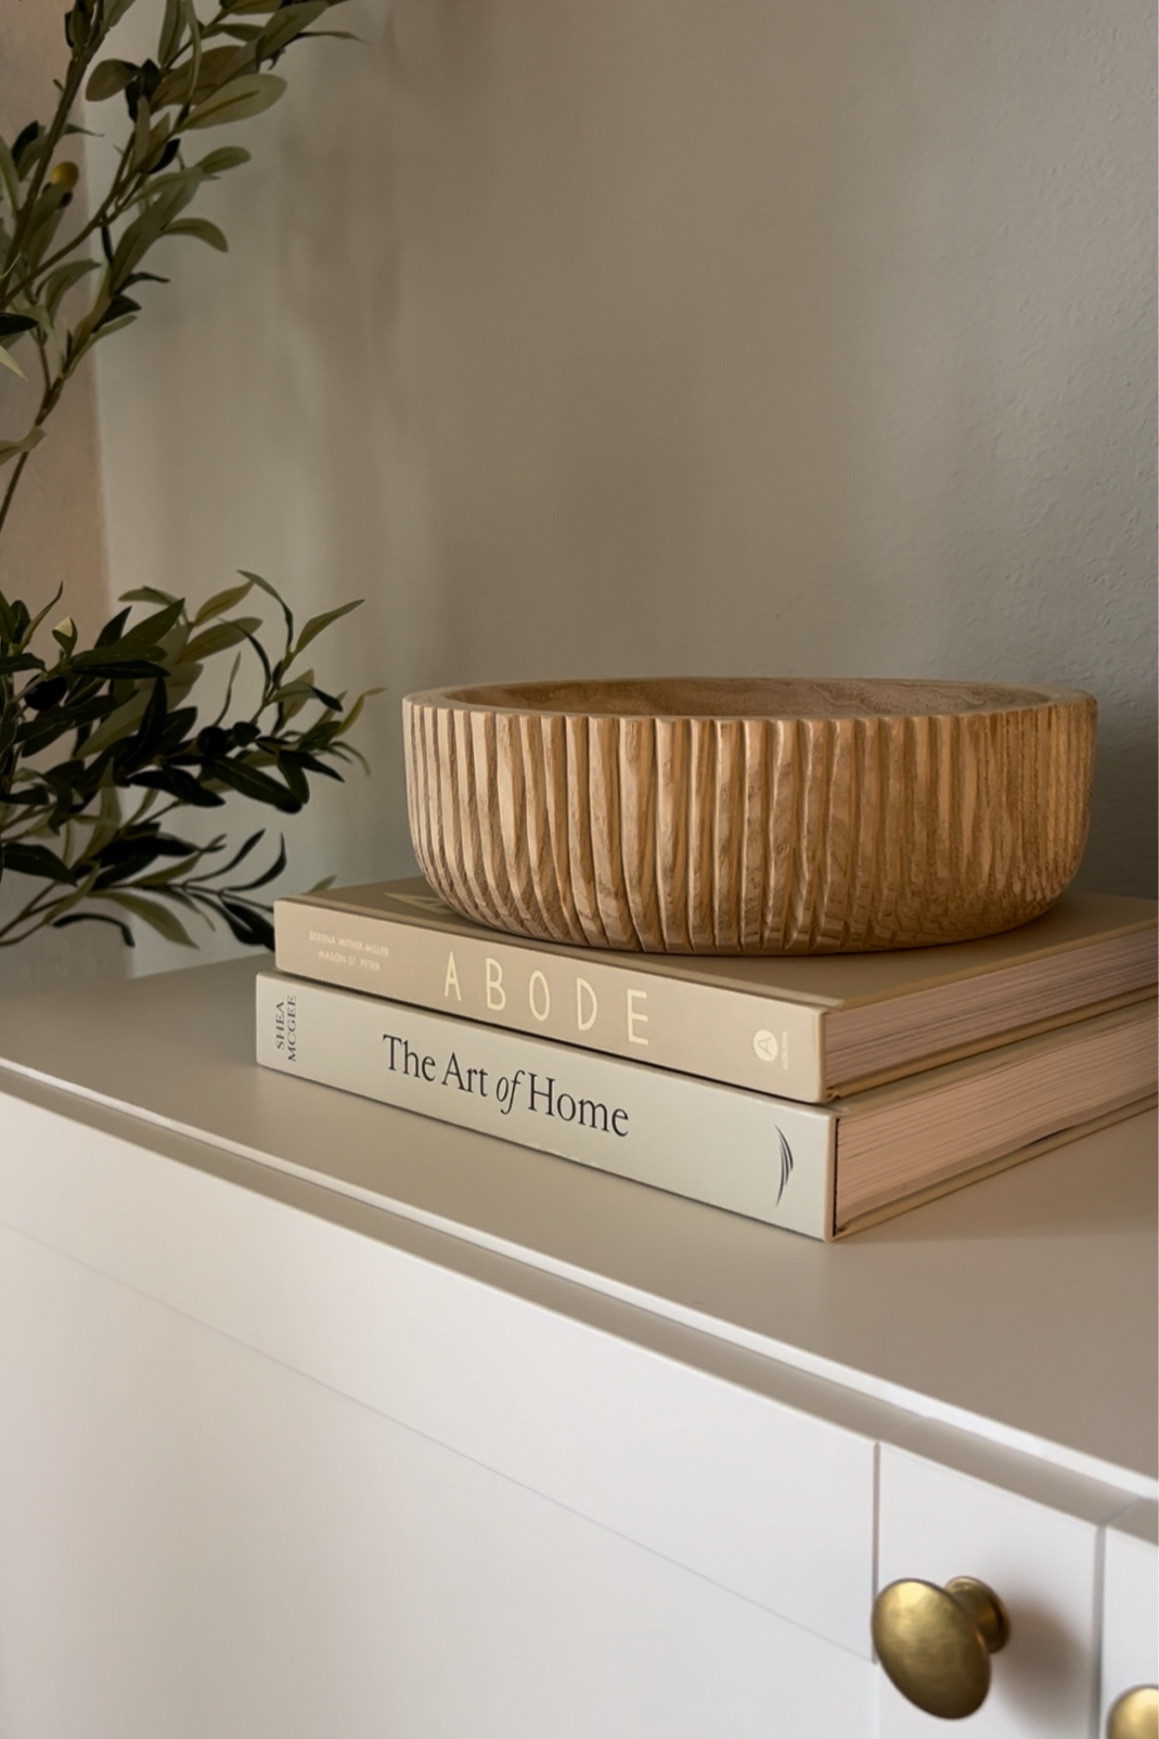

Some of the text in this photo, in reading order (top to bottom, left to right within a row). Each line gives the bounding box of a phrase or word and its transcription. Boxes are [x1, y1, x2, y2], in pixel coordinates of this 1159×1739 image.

[275, 1001, 285, 1051] SHEA
[287, 994, 297, 1063] MCGEE
[444, 950, 649, 1046] ABODE
[382, 1034, 630, 1137] The Art of Home
